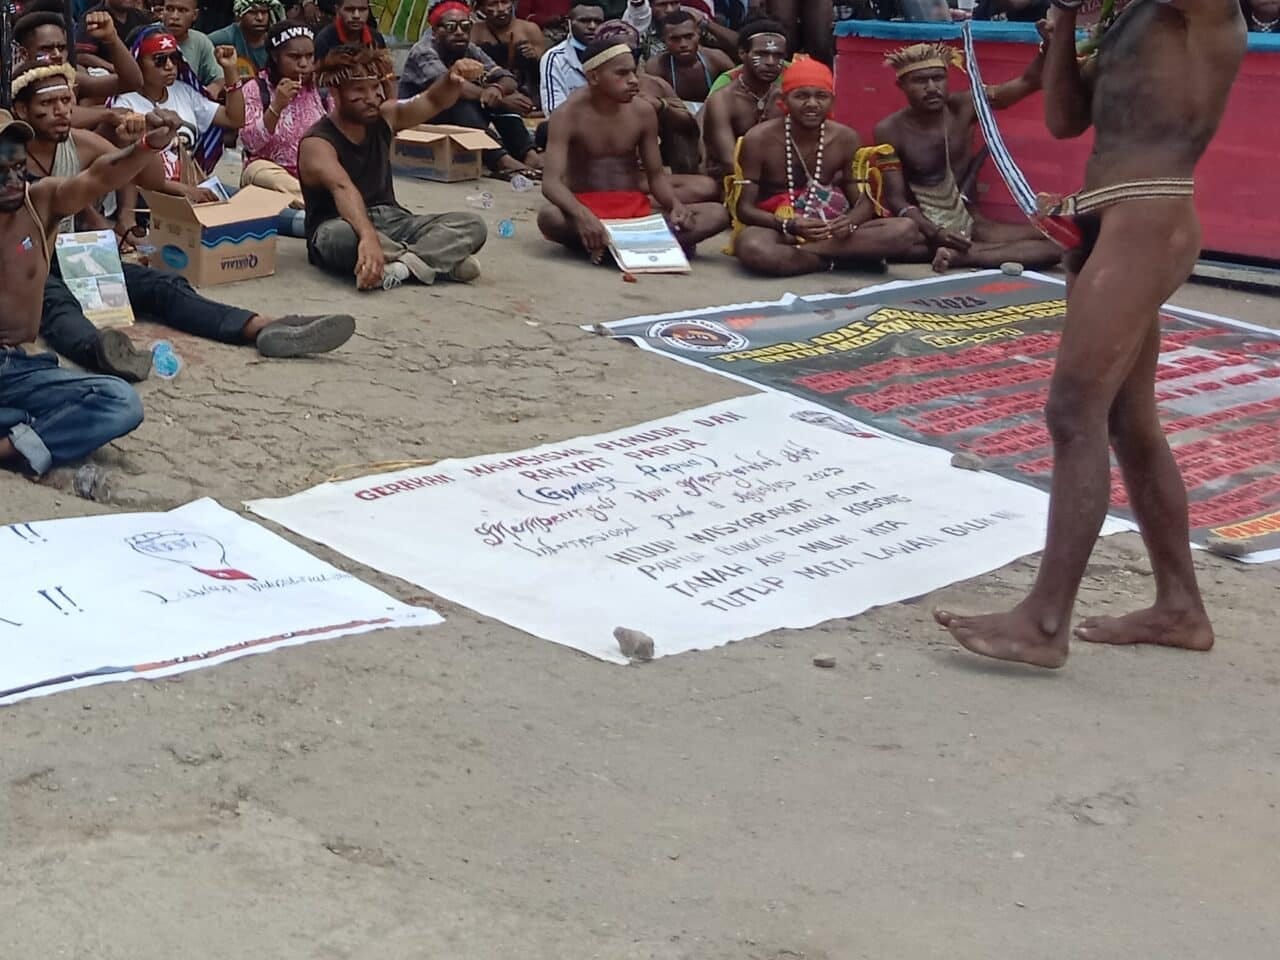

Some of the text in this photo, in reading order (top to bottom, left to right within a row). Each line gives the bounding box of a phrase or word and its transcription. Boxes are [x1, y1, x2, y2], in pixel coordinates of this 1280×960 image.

[354, 410, 748, 501] GERAKAN MAHASISWA PEMUDA DAN
[517, 438, 708, 482] RAKYAT PAPUA
[605, 480, 878, 566] HIDUP MASYARAKAT ADAT
[664, 561, 753, 599] TANAH
[798, 533, 859, 554] MILIK
[861, 518, 910, 538] KITA
[774, 512, 842, 537] TANAH
[700, 574, 786, 613] TUTUP
[793, 557, 865, 581] MATA
[861, 534, 946, 561] LAWAN
